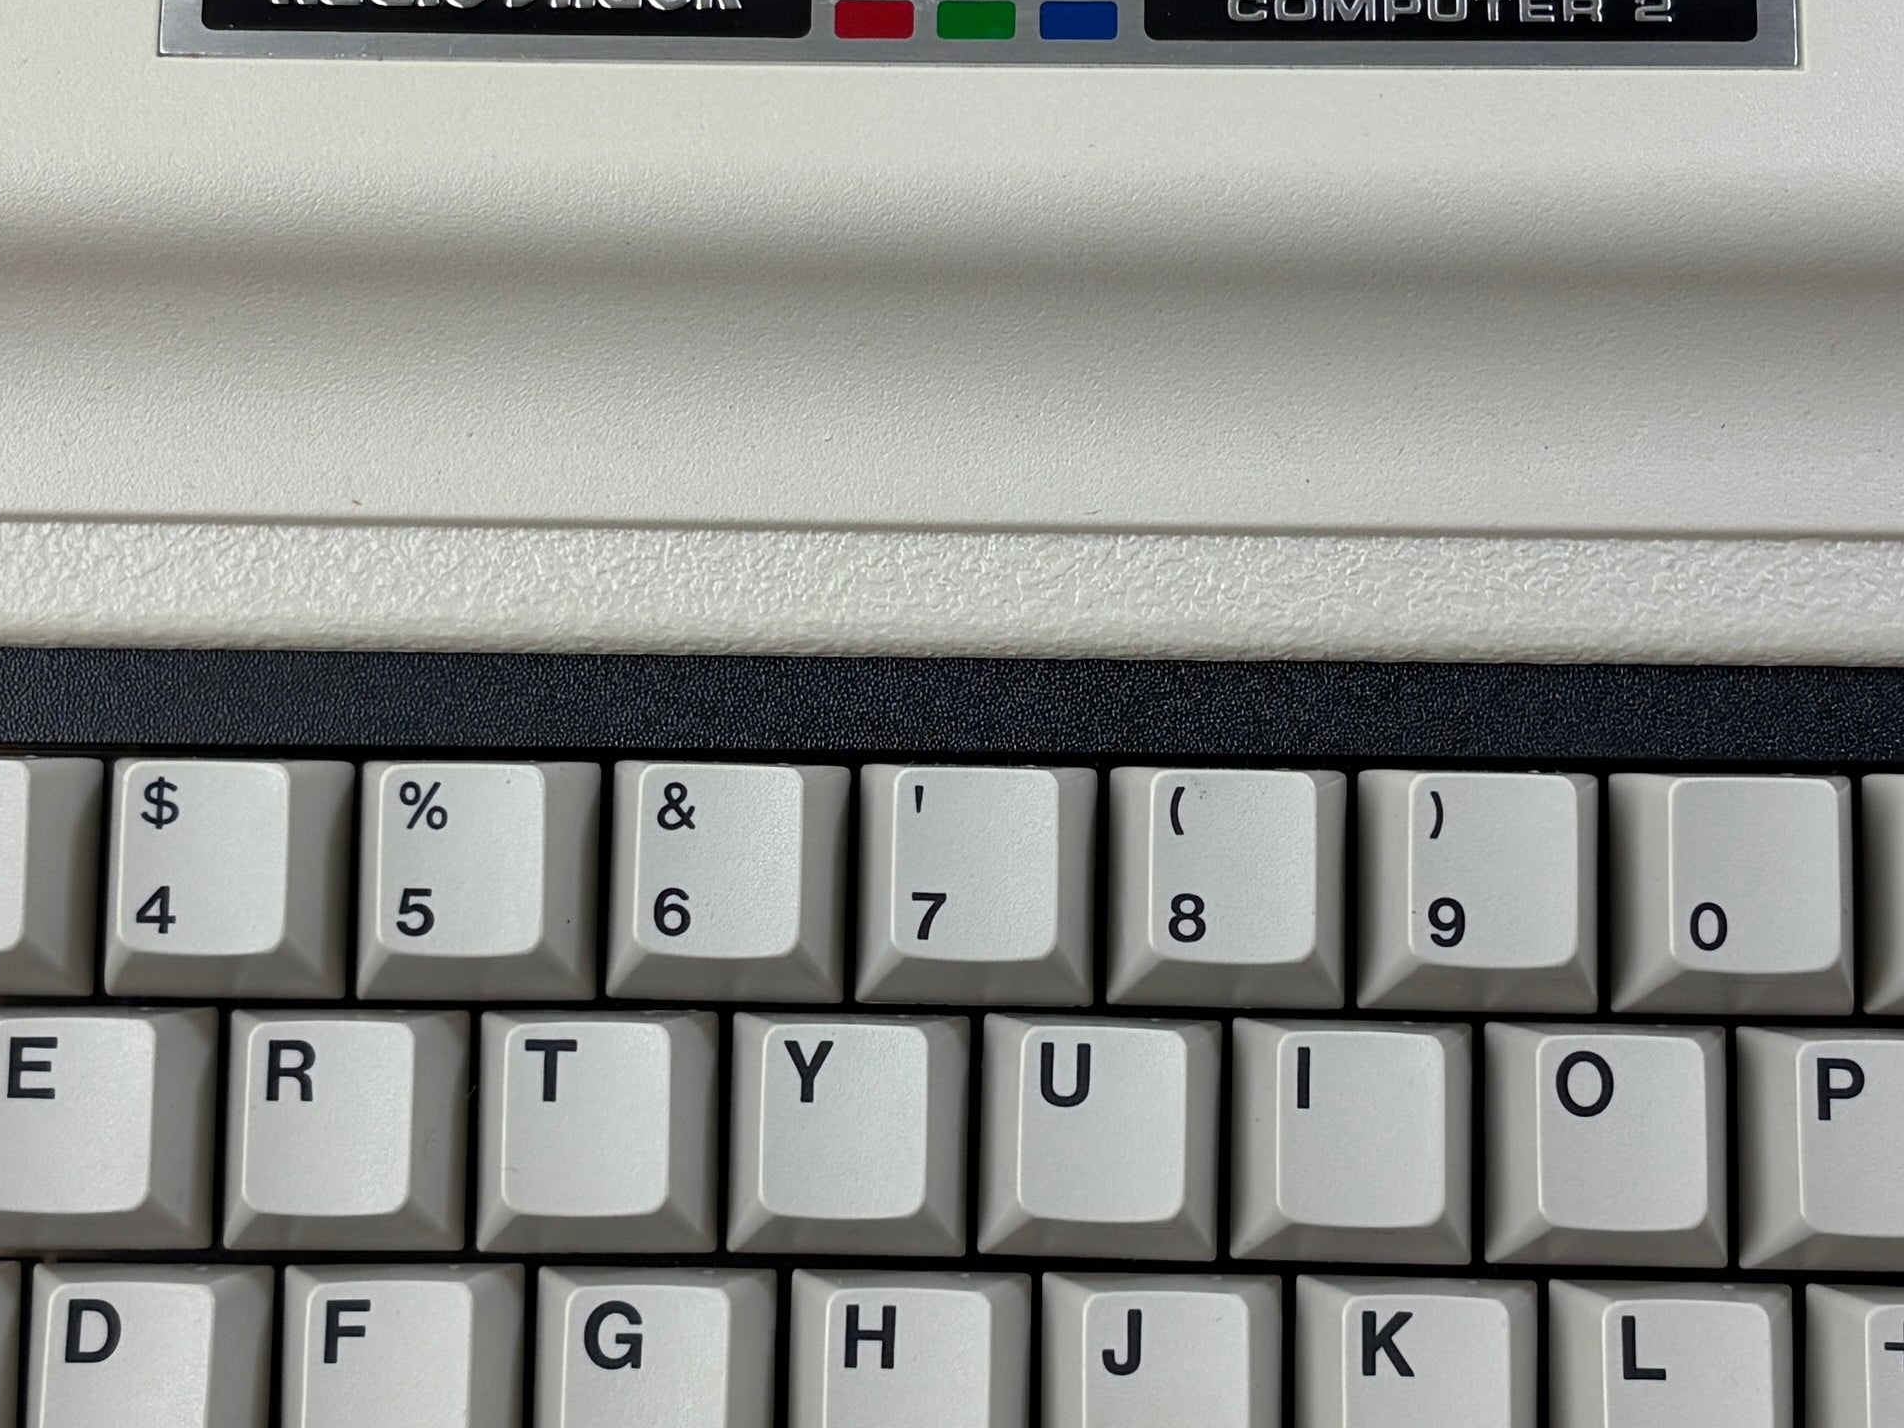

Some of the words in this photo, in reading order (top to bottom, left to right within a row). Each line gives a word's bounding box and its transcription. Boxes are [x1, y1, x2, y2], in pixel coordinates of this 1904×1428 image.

[141, 777, 178, 829] $
[400, 782, 447, 830] %
[657, 782, 695, 830] &
[1170, 787, 1185, 835] (
[1430, 791, 1443, 839] )
[136, 886, 175, 933] 4
[397, 888, 434, 936] 5
[654, 888, 690, 936] 6
[912, 892, 946, 940] 7
[1169, 893, 1206, 942] 8
[1428, 897, 1465, 947] 9
[1690, 902, 1727, 951] 0
[7, 1037, 57, 1099] E
[266, 1040, 315, 1101] R
[525, 1039, 577, 1102] T
[784, 1040, 833, 1102] Y
[1041, 1042, 1091, 1107] U
[1297, 1047, 1310, 1109] I
[1556, 1051, 1614, 1117] O
[1817, 1058, 1865, 1120] P
[65, 1299, 121, 1363] D
[324, 1300, 370, 1363] F
[584, 1301, 642, 1370] G
[844, 1305, 896, 1369] H
[1102, 1309, 1142, 1375] J
[1362, 1311, 1414, 1377] K
[1622, 1316, 1666, 1380] L
